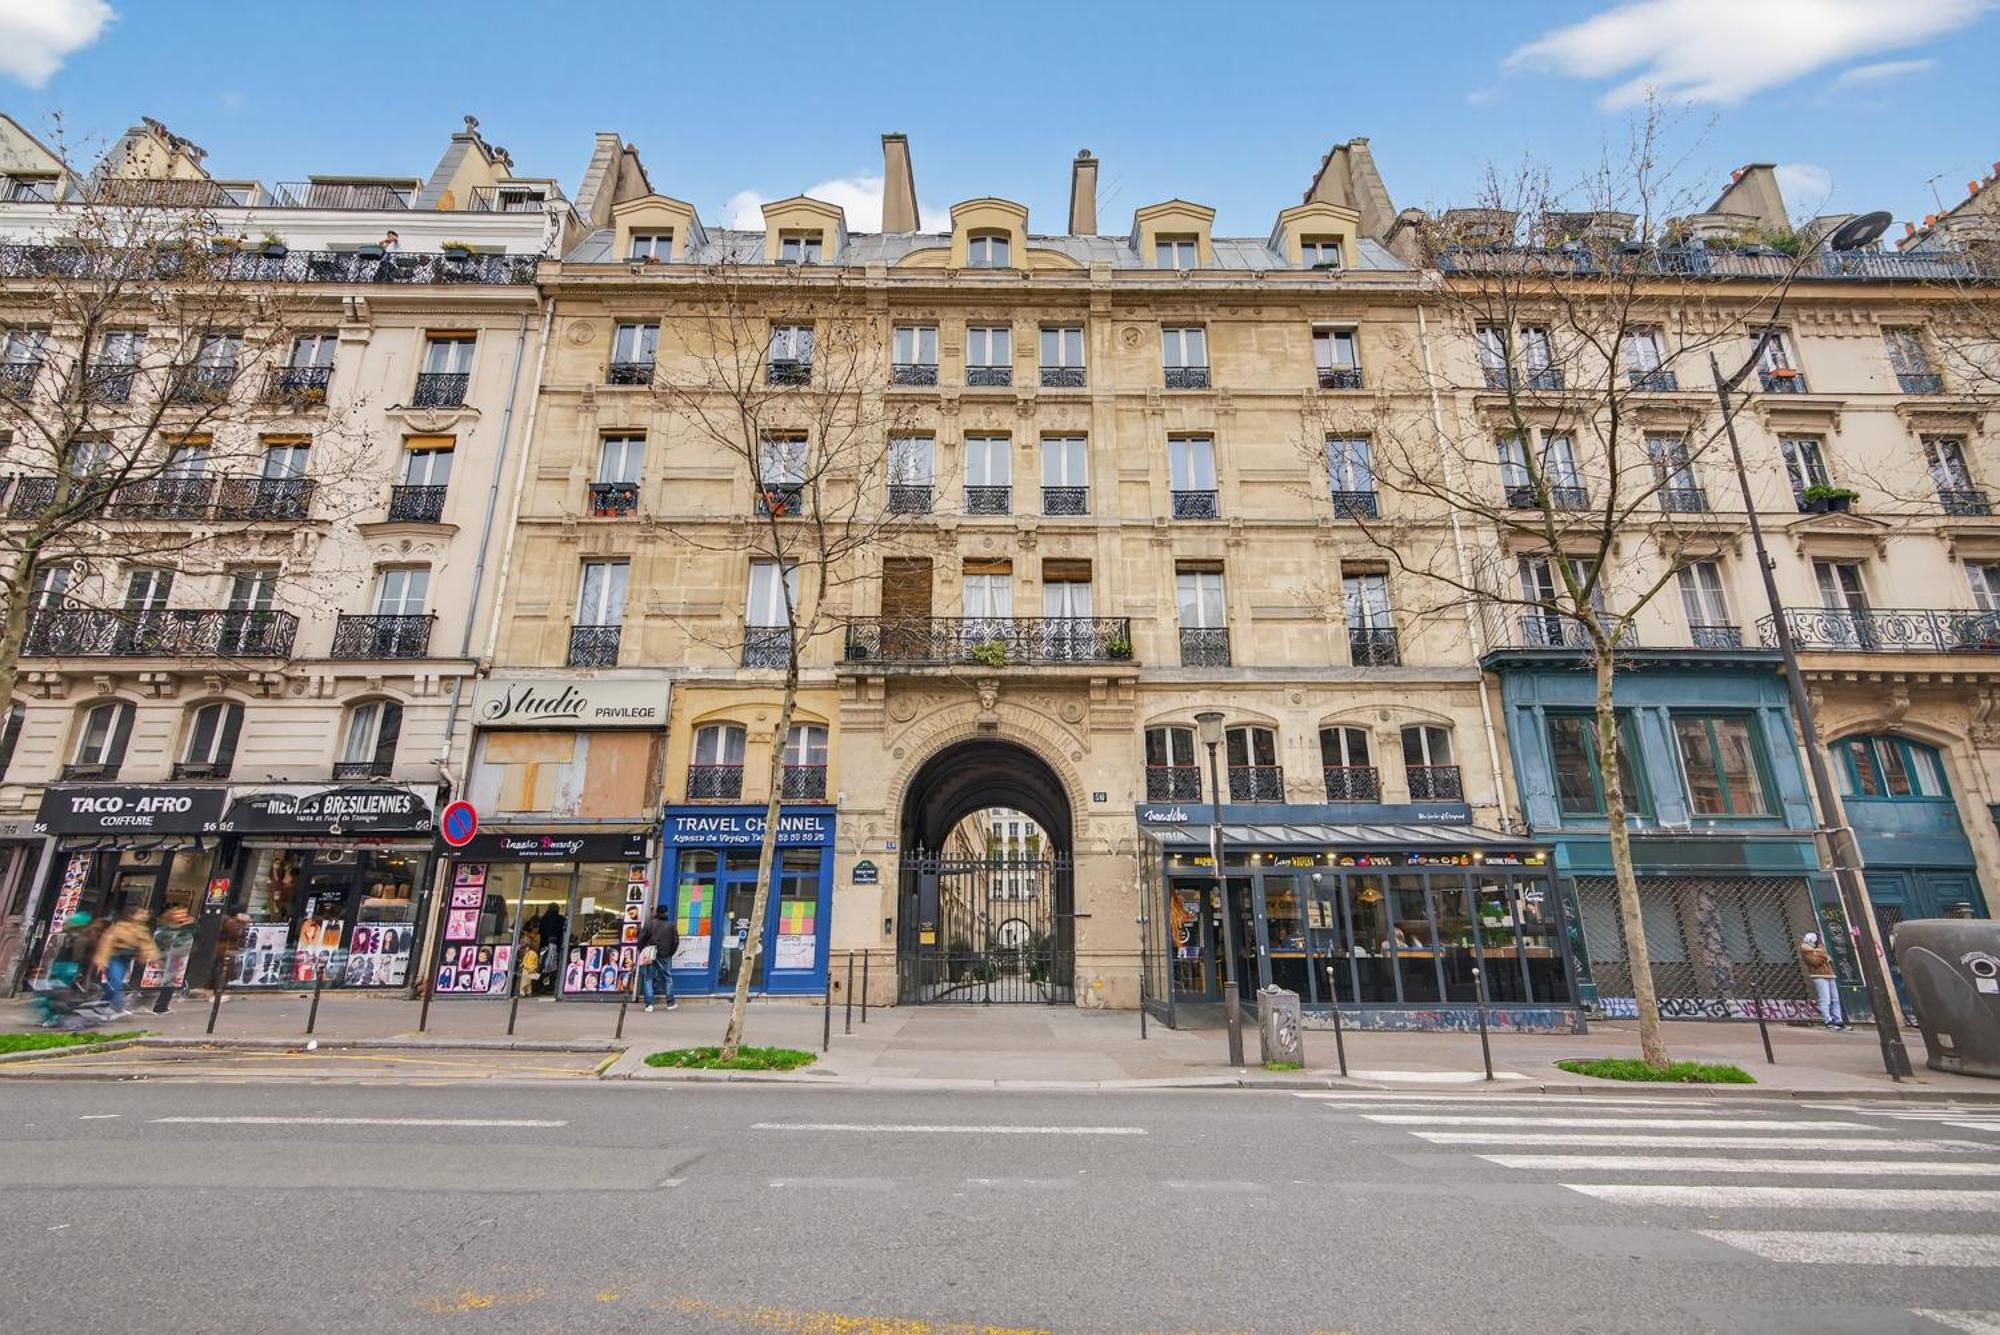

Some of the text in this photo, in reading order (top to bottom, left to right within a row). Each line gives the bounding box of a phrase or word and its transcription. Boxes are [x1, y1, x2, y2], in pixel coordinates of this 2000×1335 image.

[482, 684, 656, 721] Studio PRIVILEGE
[71, 796, 123, 813] TACO
[136, 796, 192, 813] AFRO
[100, 816, 154, 826] COIFFURE
[203, 822, 217, 831] 56
[676, 818, 740, 831] TRAVEL
